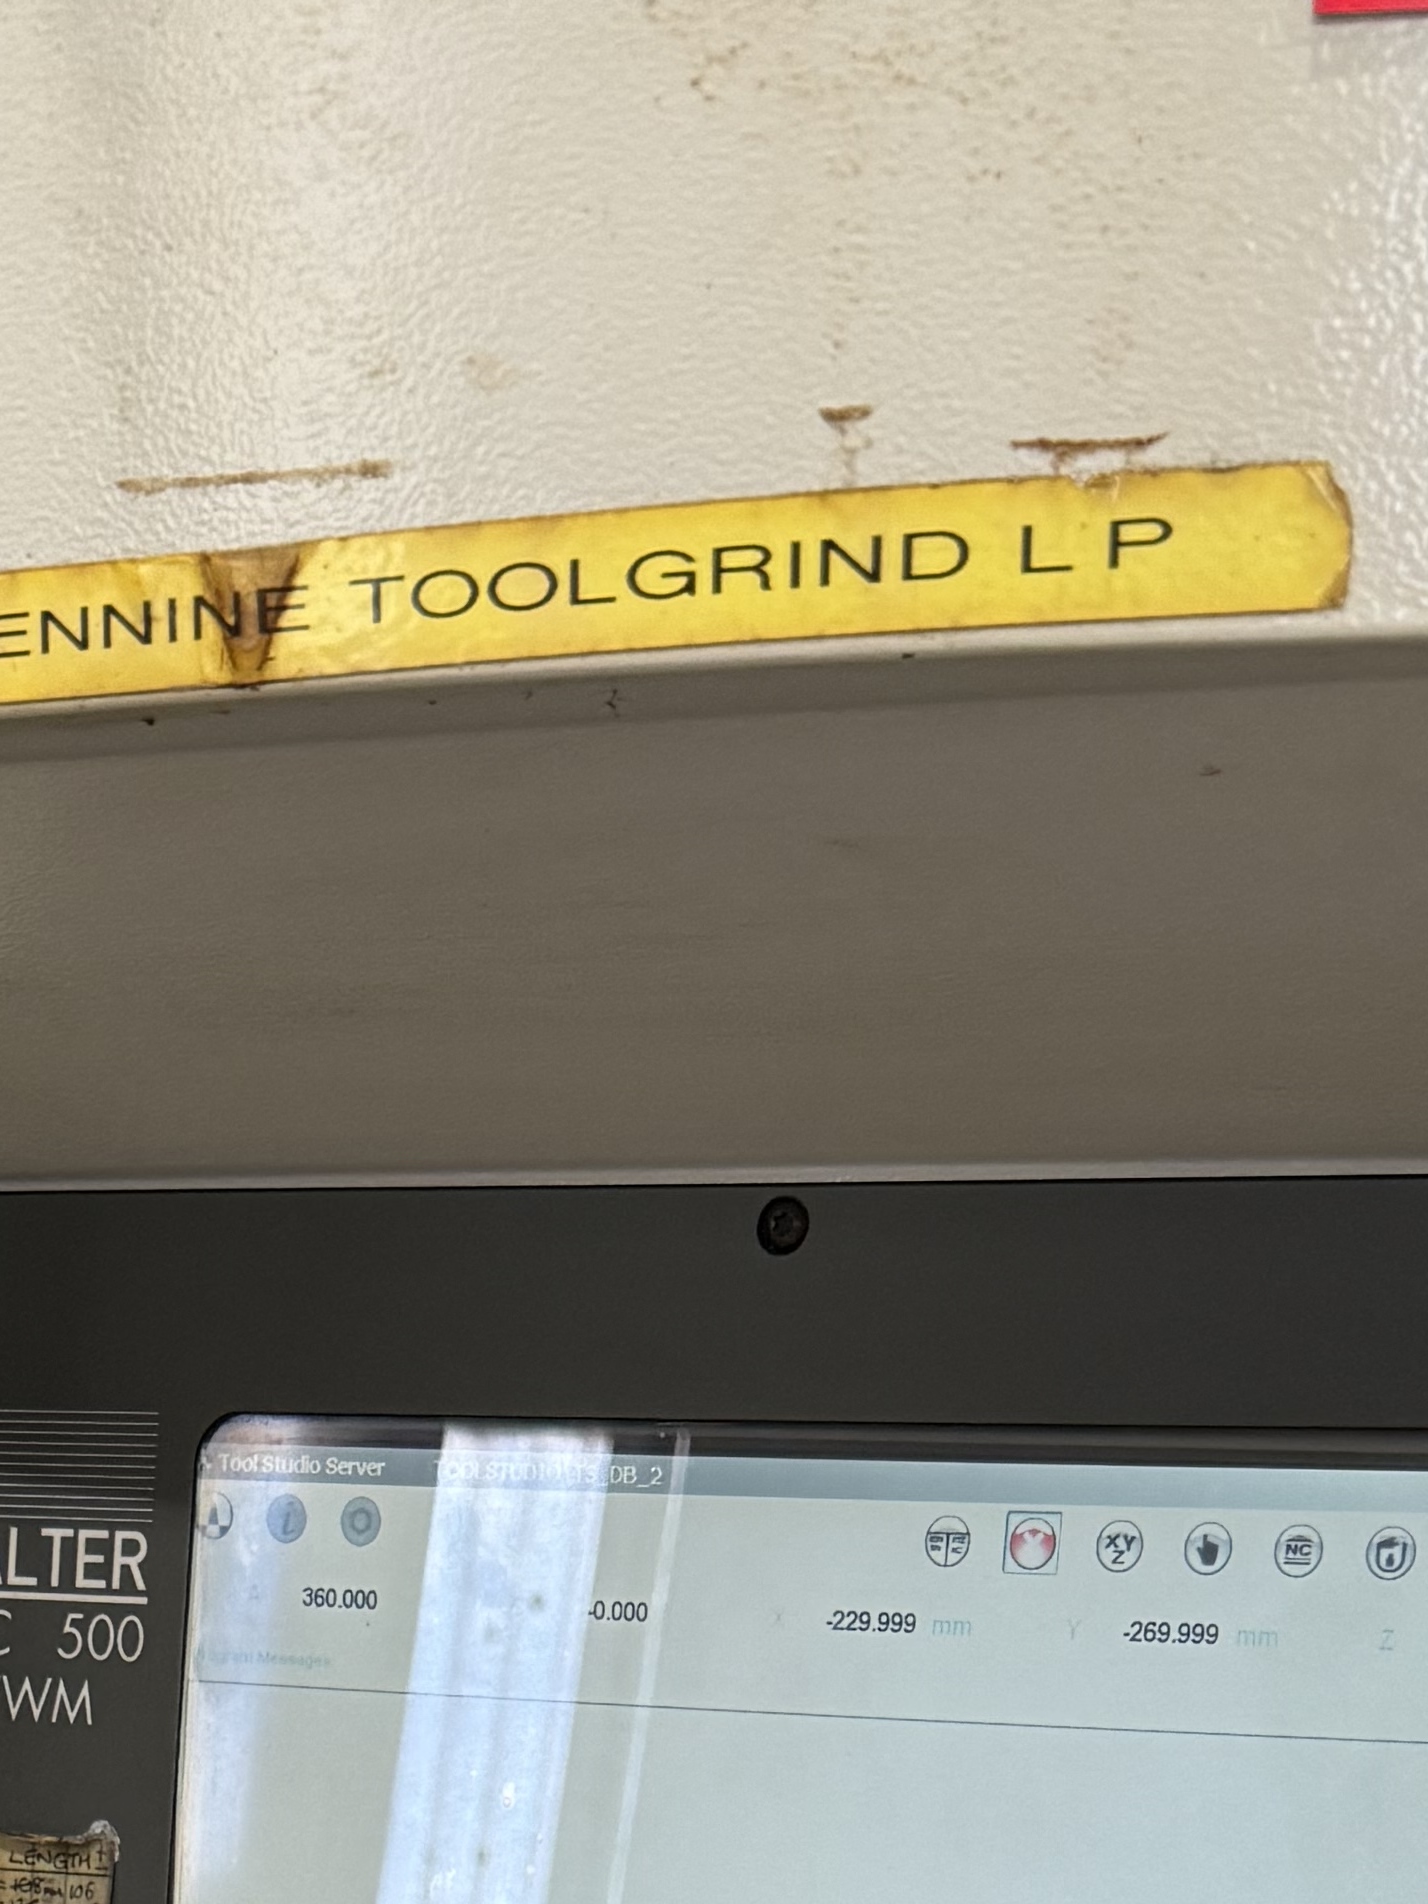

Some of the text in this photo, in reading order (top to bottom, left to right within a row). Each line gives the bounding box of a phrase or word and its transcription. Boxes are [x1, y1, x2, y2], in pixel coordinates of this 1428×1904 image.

[349, 529, 972, 625] TOOLGRIND
[218, 1453, 386, 1477] Tool Studio Server
[57, 1612, 145, 1662] 500
[301, 1587, 378, 1610] 360.000
[587, 1600, 649, 1623] -0.000
[826, 1611, 917, 1635] -229.999
[1123, 1622, 1219, 1646] -269.999
[9, 1849, 91, 1871] LENGTH
